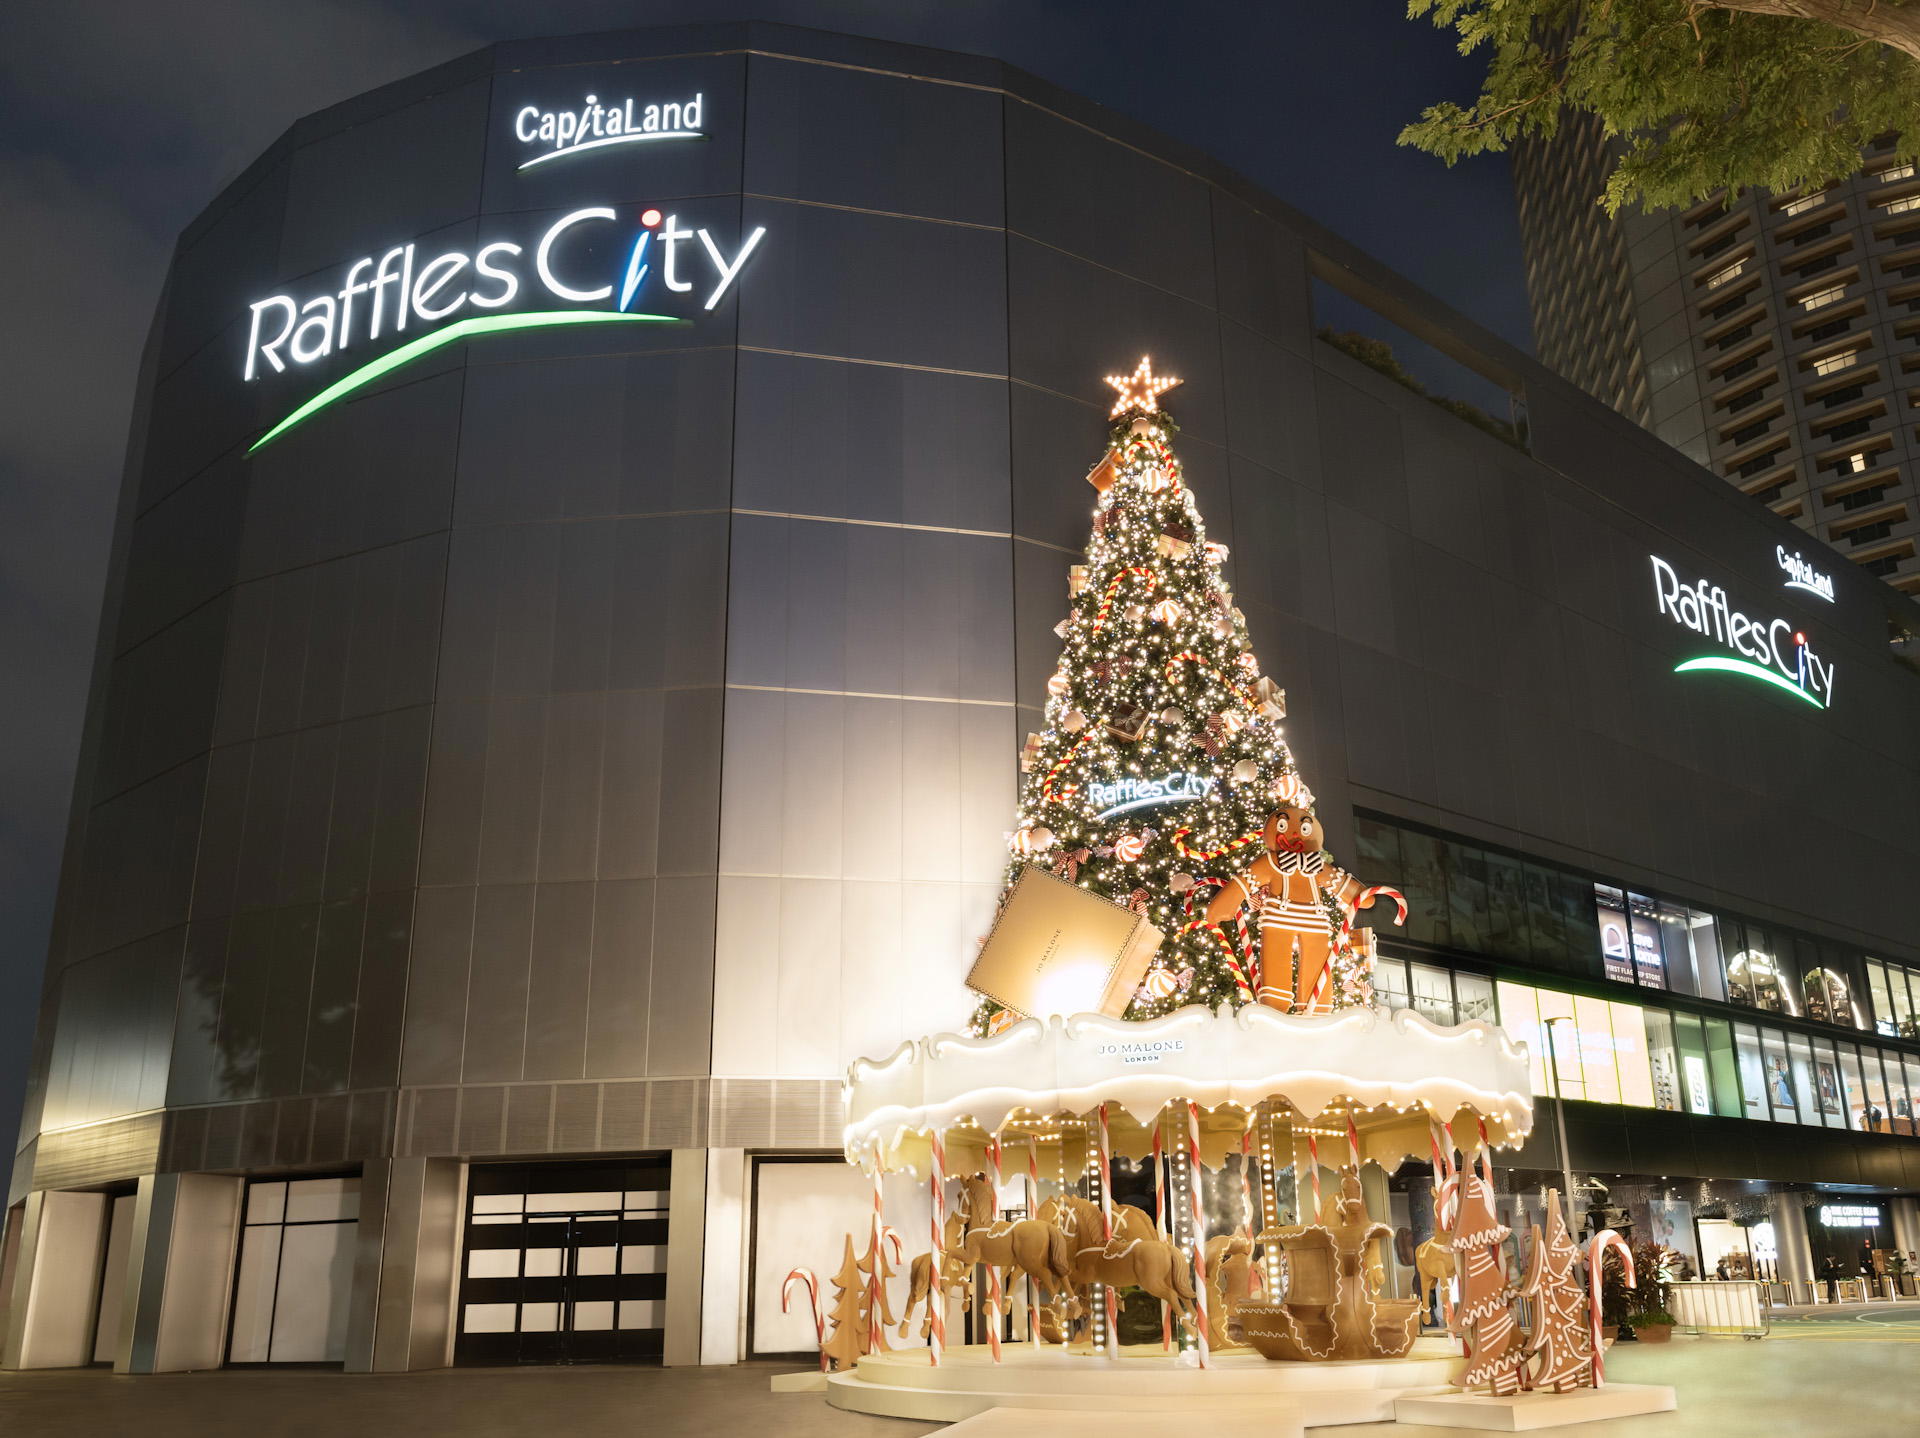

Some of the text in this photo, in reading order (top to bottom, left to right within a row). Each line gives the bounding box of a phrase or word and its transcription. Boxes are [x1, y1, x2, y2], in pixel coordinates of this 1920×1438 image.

[515, 92, 703, 148] CapitaLand
[1776, 544, 1834, 598] CapitaLand
[1606, 964, 1620, 973] FIRST
[1645, 972, 1661, 982] STORE
[1098, 1040, 1183, 1055] JO MALONE
[1124, 1055, 1159, 1063] LONDON
